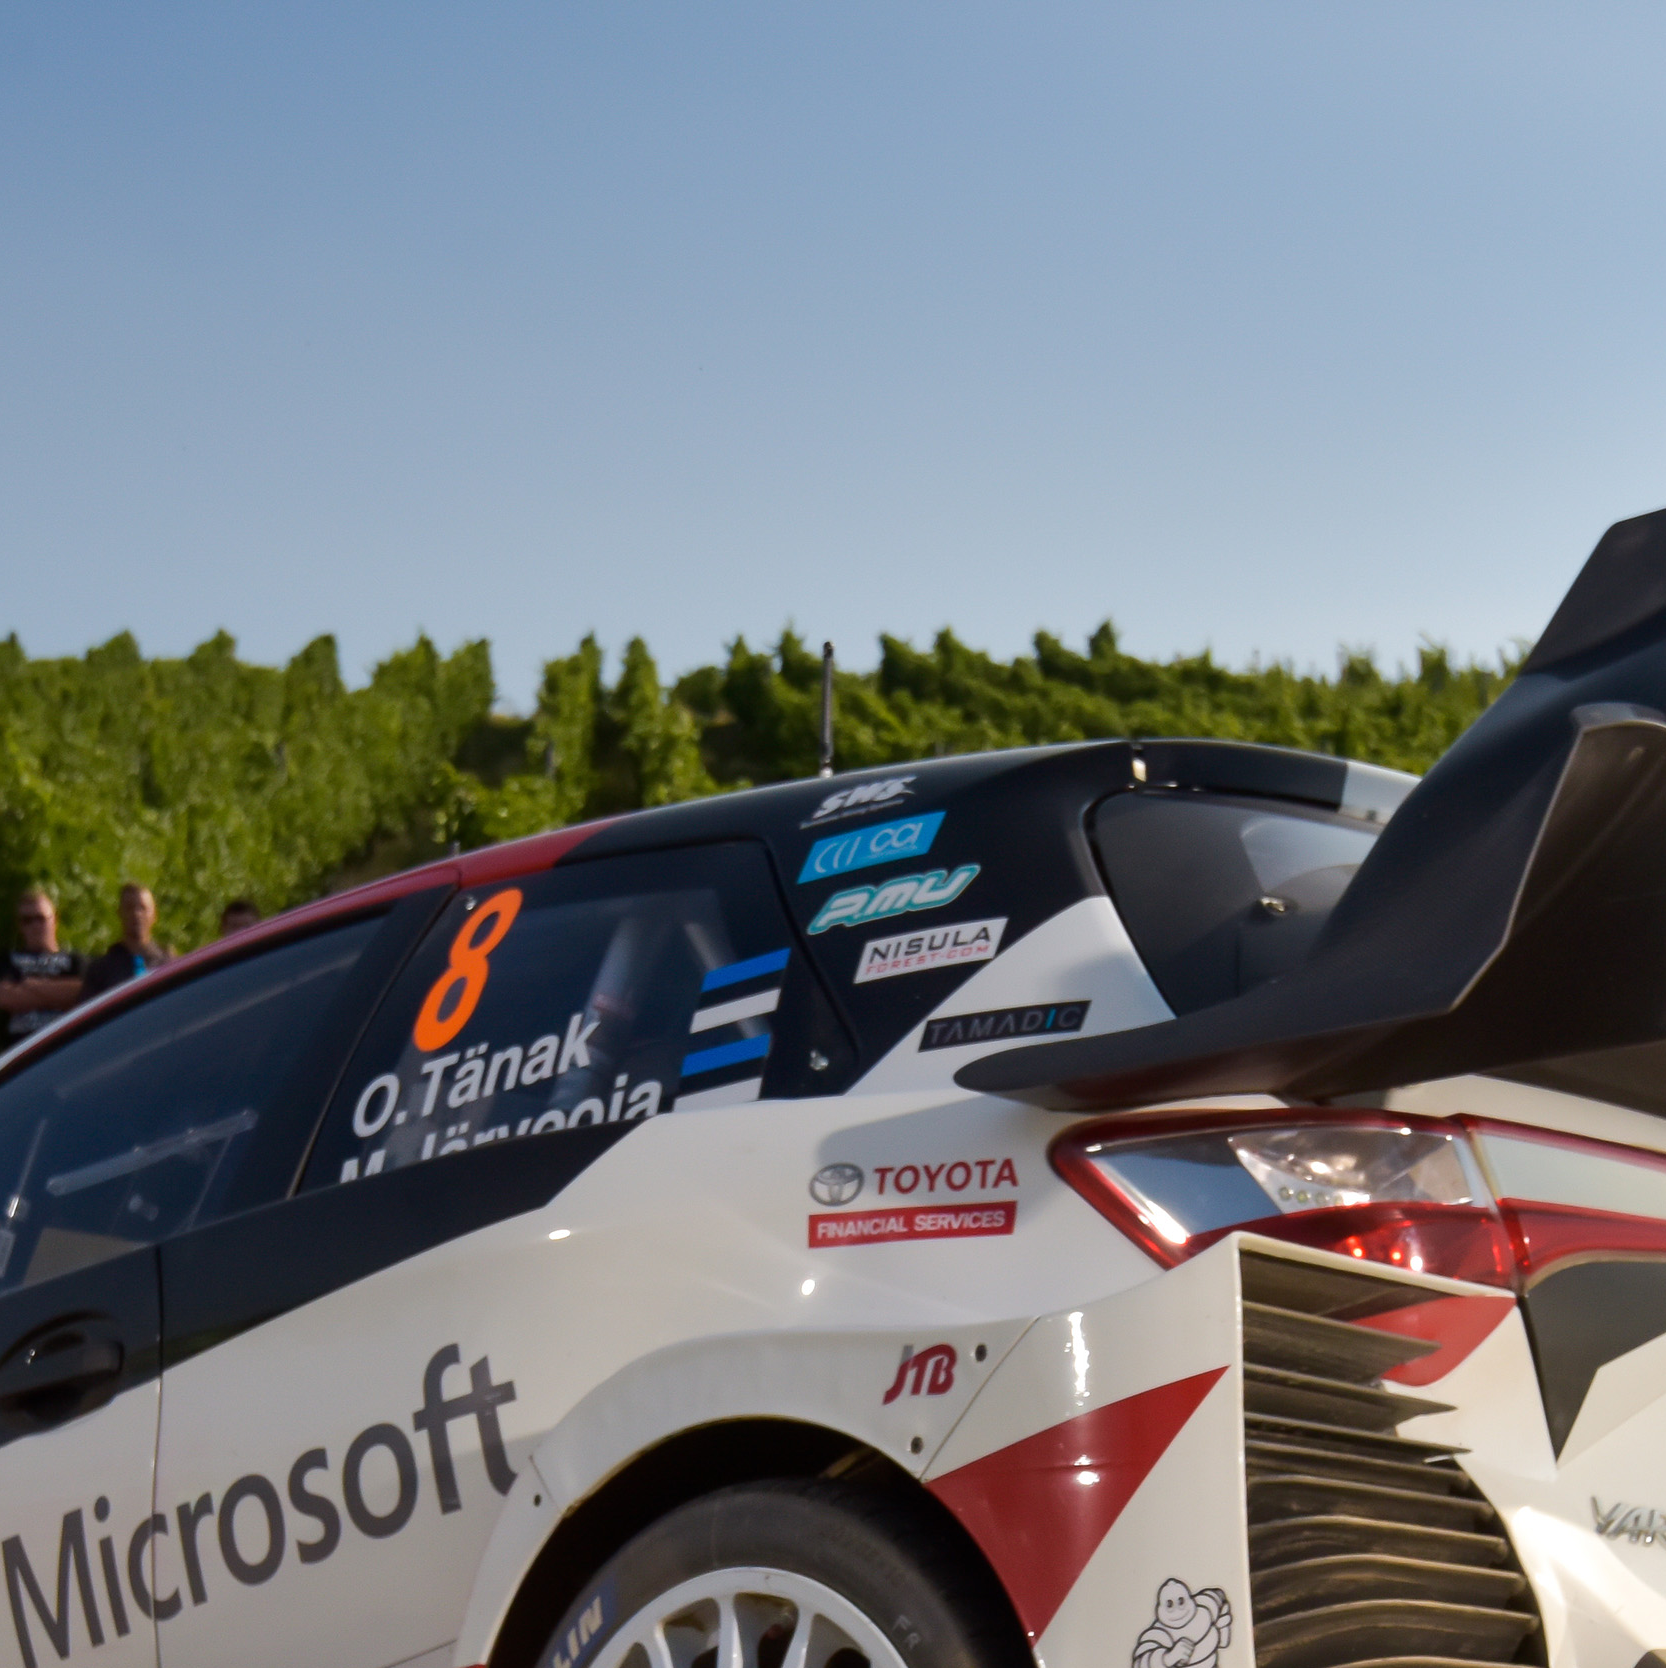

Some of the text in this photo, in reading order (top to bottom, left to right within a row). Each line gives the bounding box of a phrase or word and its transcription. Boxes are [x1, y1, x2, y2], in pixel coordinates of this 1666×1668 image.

[869, 926, 991, 964] NISULA
[412, 887, 524, 1052] 8
[930, 1006, 1083, 1046] TAMADIC
[874, 1158, 1020, 1196] TOYOTA
[816, 1210, 1007, 1240] FINANCIAL SERVICES
[882, 1341, 958, 1405] JTB
